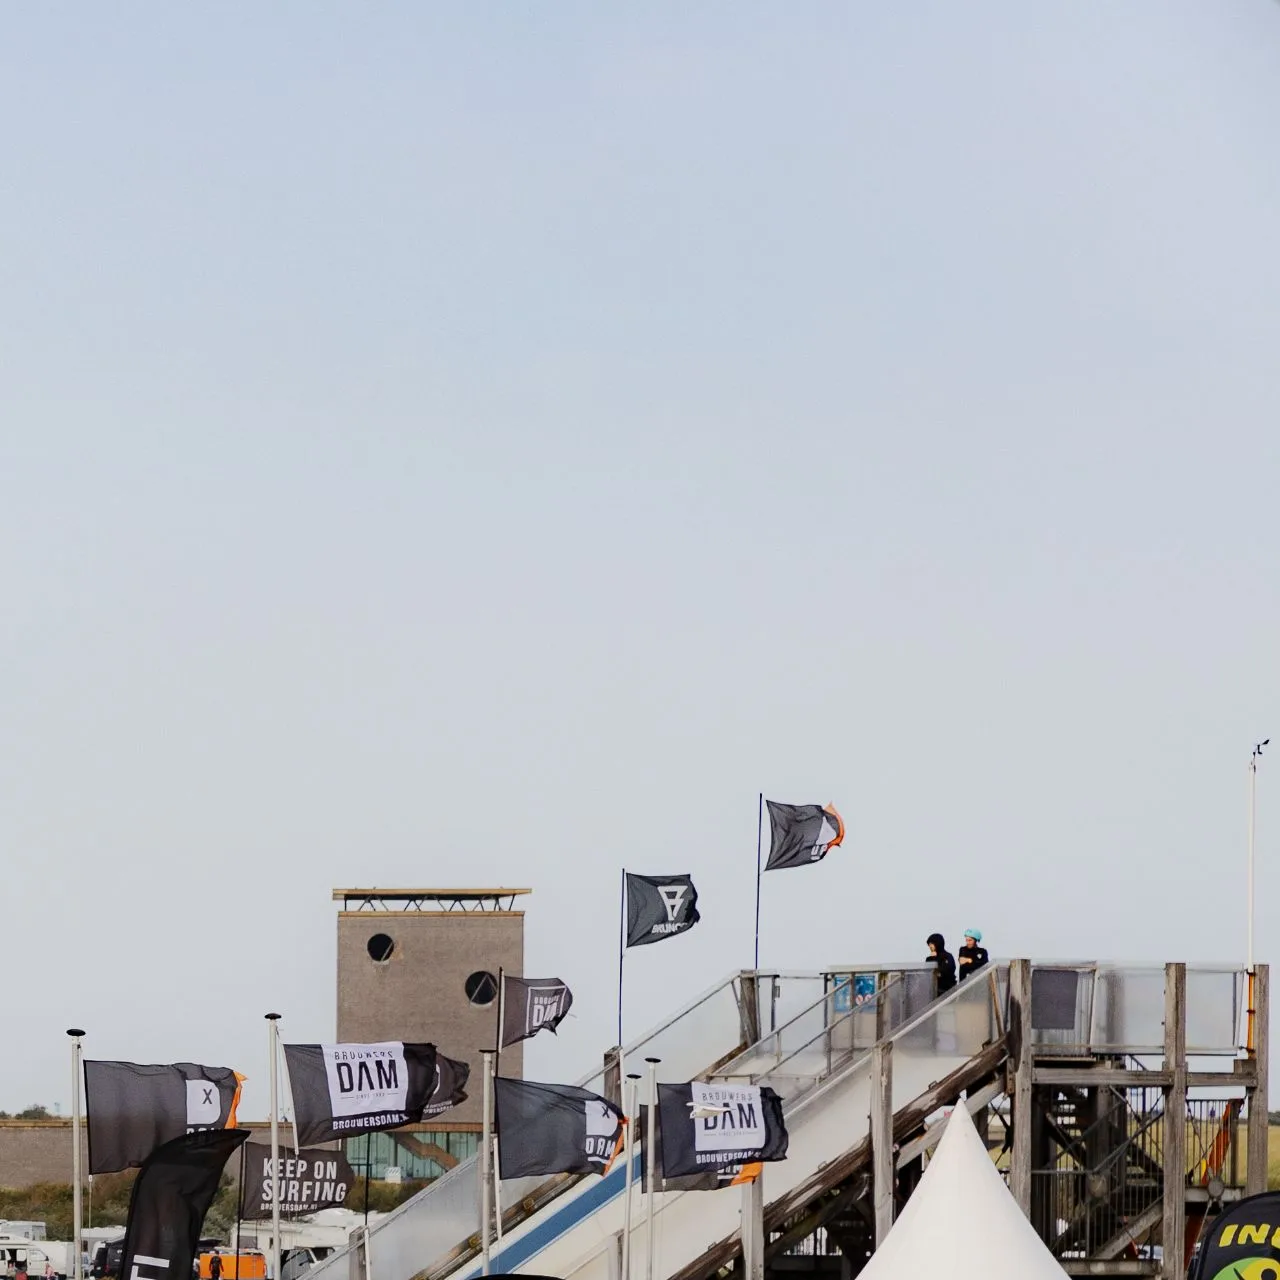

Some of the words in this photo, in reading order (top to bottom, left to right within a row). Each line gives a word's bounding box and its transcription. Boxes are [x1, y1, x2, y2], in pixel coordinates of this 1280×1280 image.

[336, 1059, 399, 1093] DAM
[262, 1157, 308, 1178] KEEP
[313, 1160, 337, 1180] ON
[261, 1179, 347, 1203] SURFING
